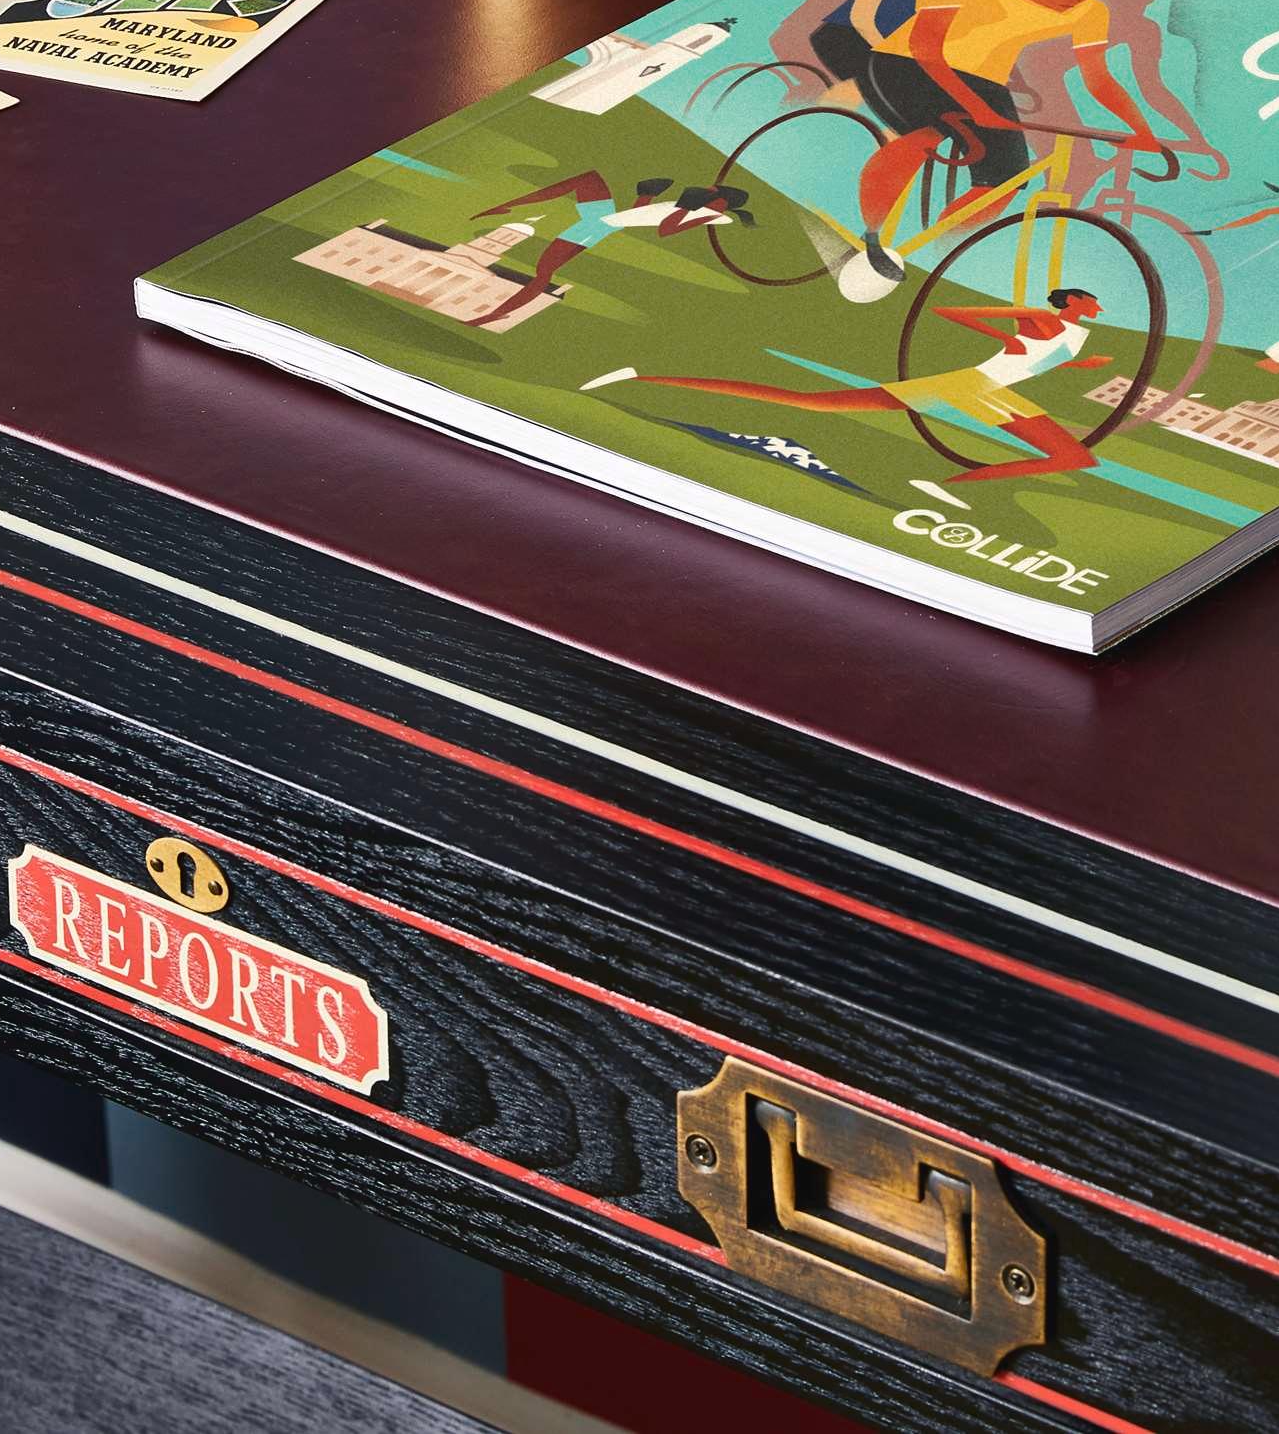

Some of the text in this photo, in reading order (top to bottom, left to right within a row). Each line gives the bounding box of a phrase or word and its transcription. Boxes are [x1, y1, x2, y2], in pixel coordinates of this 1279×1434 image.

[58, 29, 193, 60] home of the
[99, 17, 238, 49] MARYLAND
[3, 36, 84, 60] NAVAL
[83, 51, 204, 79] ACADEMY
[51, 877, 349, 1066] REPORTS
